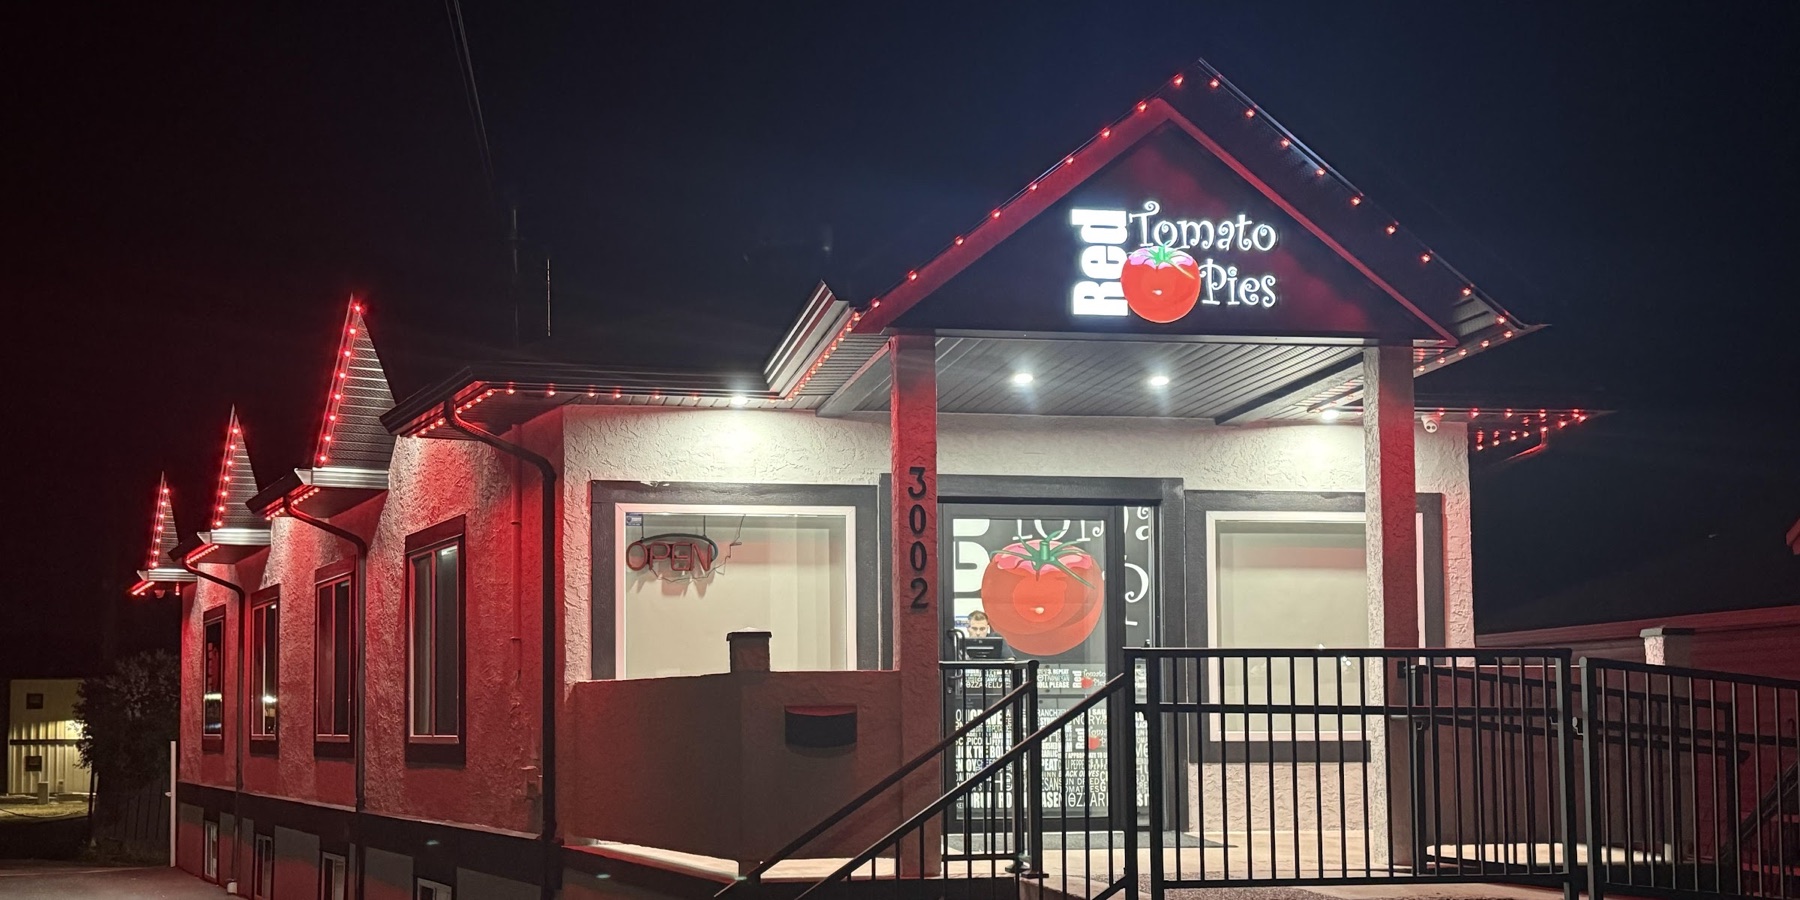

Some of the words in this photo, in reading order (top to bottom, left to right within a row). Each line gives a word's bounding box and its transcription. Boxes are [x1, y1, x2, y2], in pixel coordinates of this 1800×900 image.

[1129, 200, 1277, 252] Tomato
[1071, 208, 1128, 316] Red
[1200, 258, 1277, 308] Pies
[626, 541, 713, 572] OPEN
[907, 466, 929, 610] 3002
[1072, 671, 1082, 688] Red
